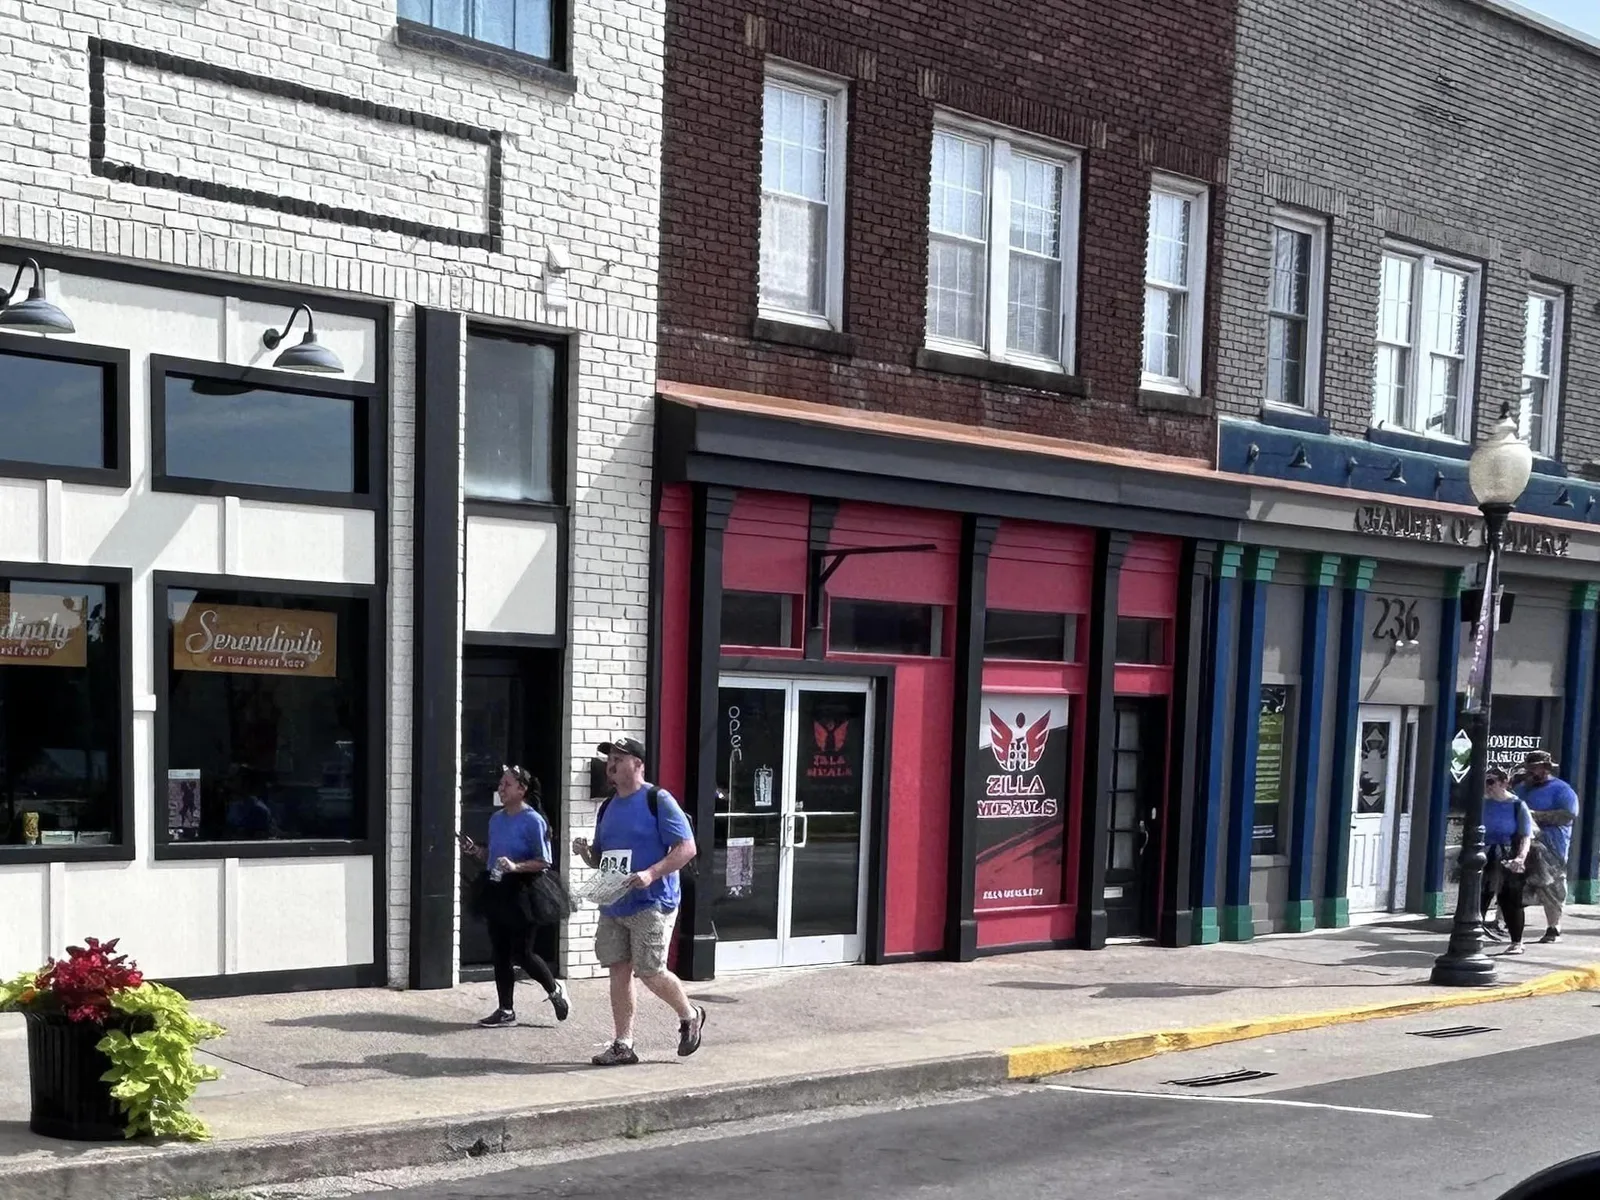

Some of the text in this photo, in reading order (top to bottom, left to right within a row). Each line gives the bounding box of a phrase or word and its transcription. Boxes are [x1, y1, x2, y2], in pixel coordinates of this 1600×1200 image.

[1372, 597, 1420, 640] 236
[185, 610, 323, 661] Serendipity
[986, 775, 1046, 796] ZILLA
[977, 799, 1058, 819] MEALS
